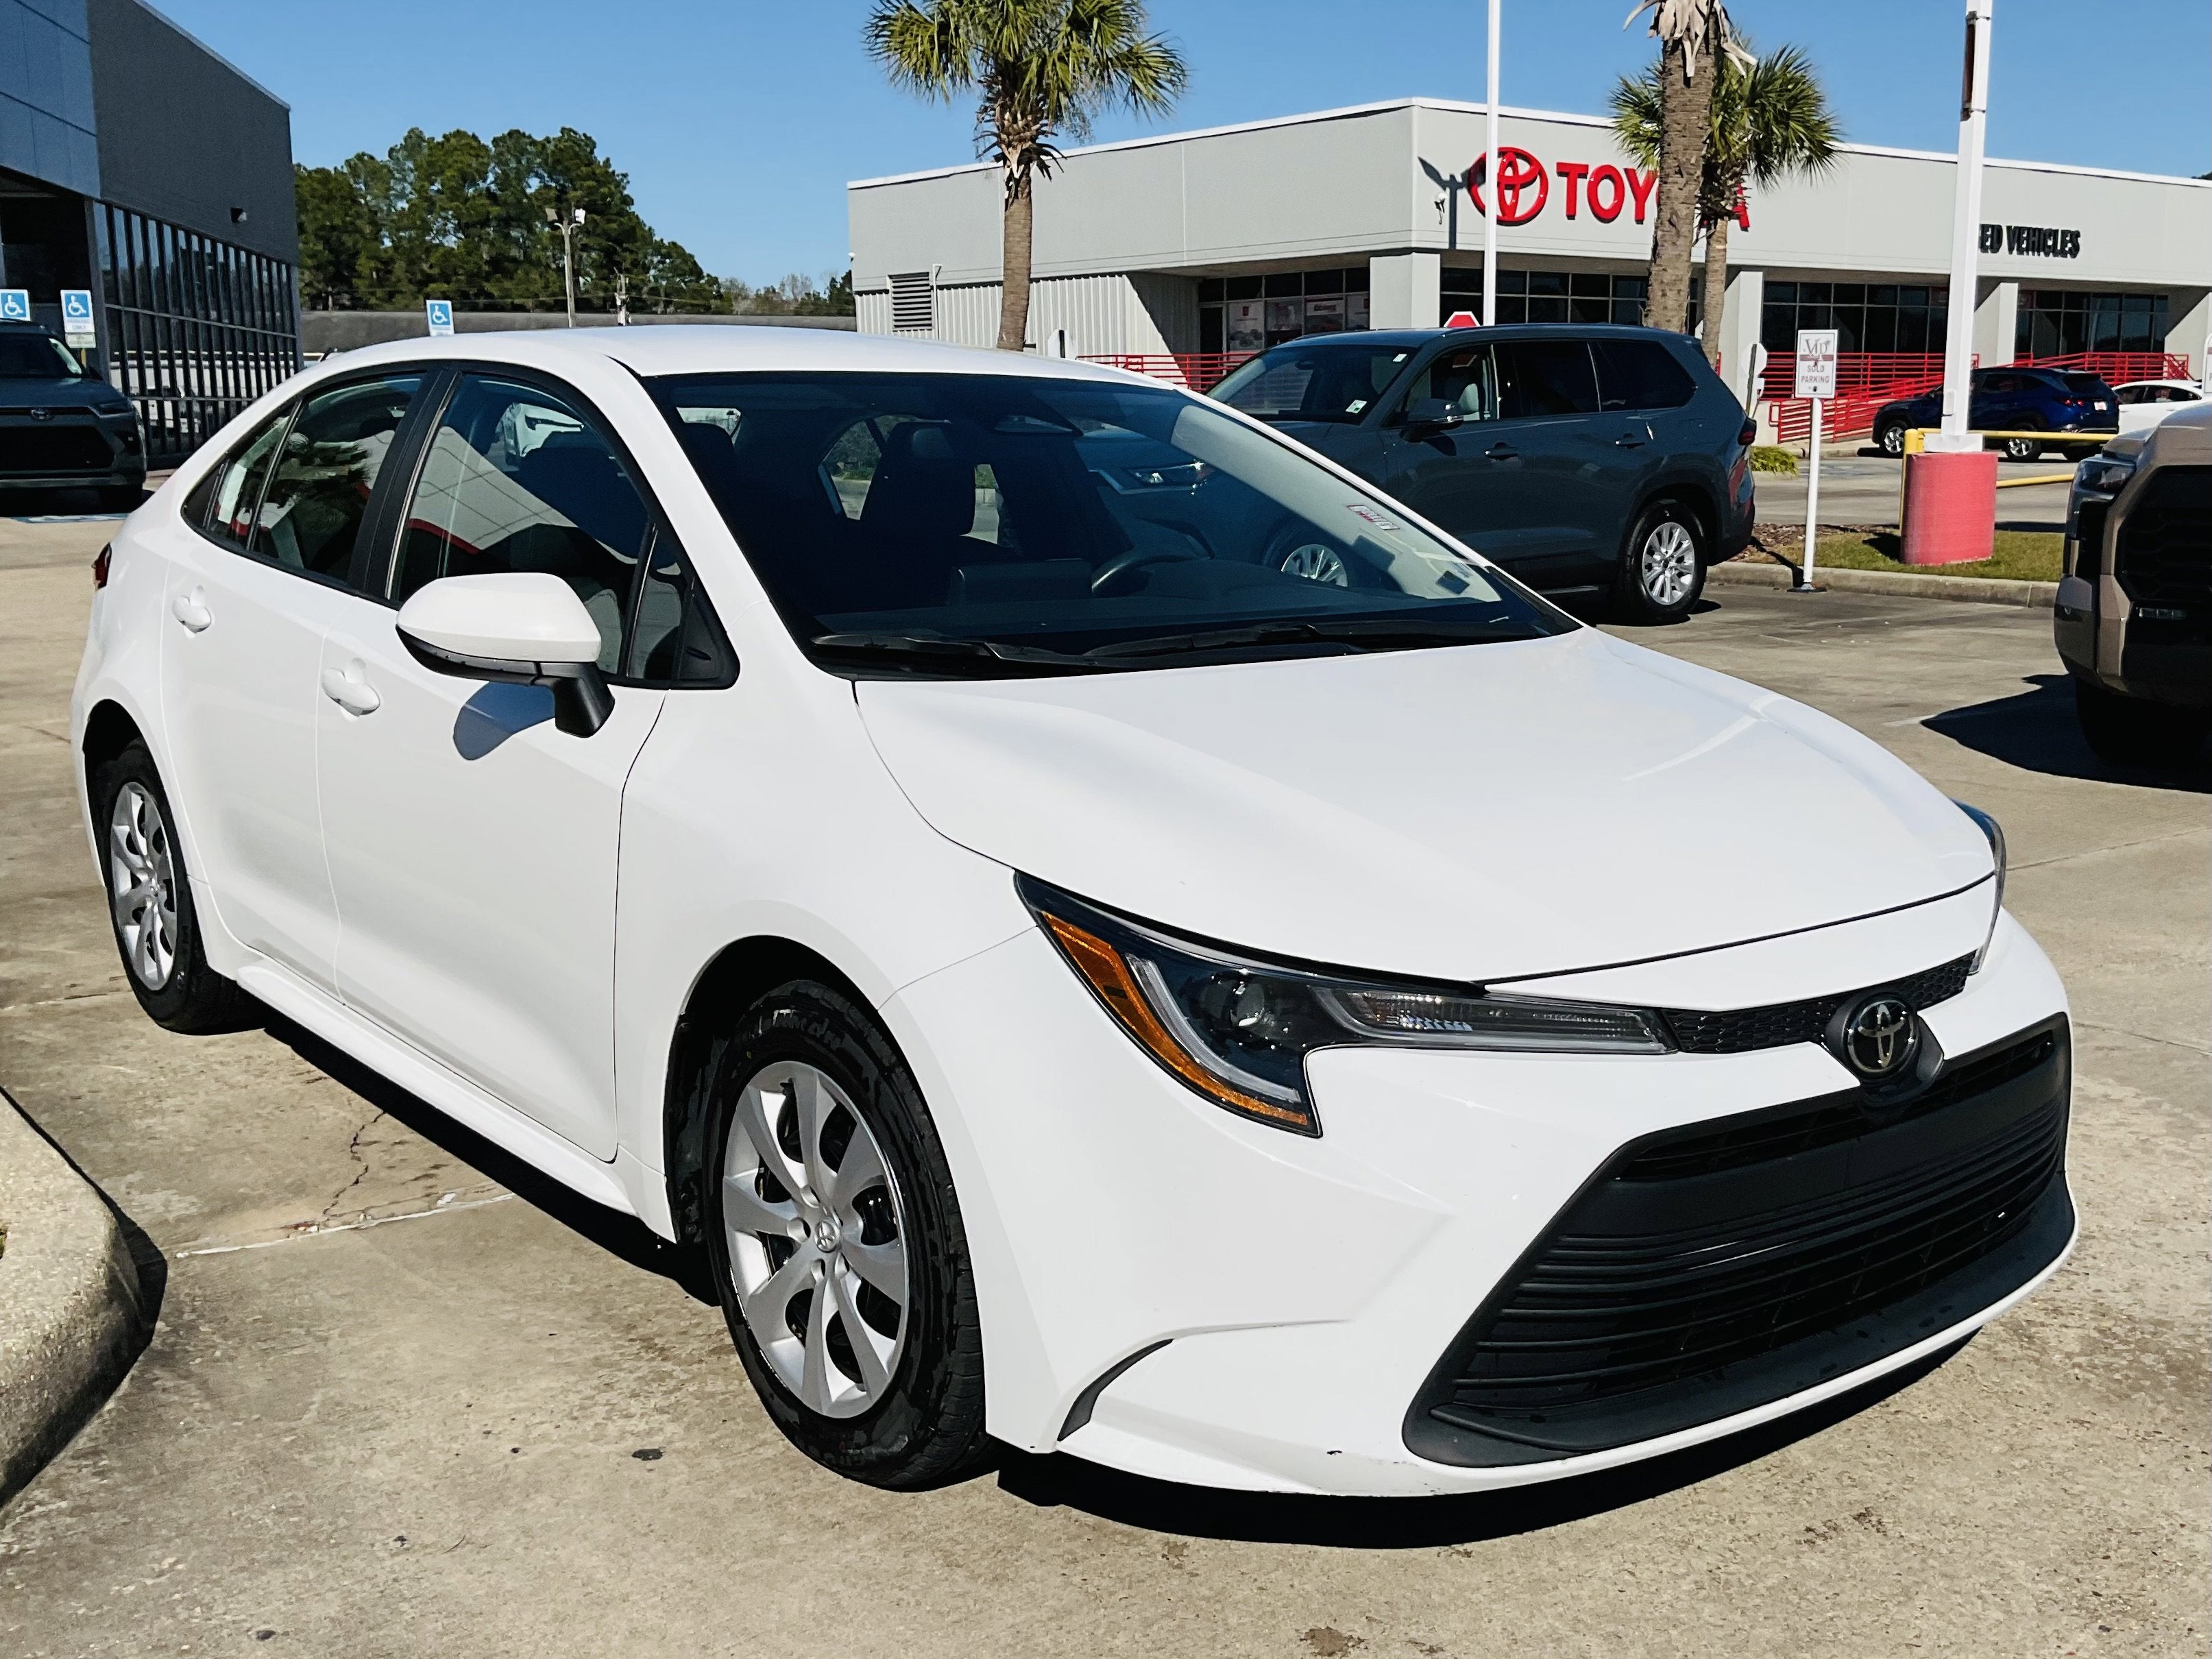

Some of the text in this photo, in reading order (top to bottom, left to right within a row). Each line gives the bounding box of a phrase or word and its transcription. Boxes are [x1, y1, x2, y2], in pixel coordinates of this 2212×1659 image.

[1556, 162, 1750, 232] TOY
[1979, 223, 2080, 258] ED VEHICLES
[1801, 375, 1830, 383] PARKING
